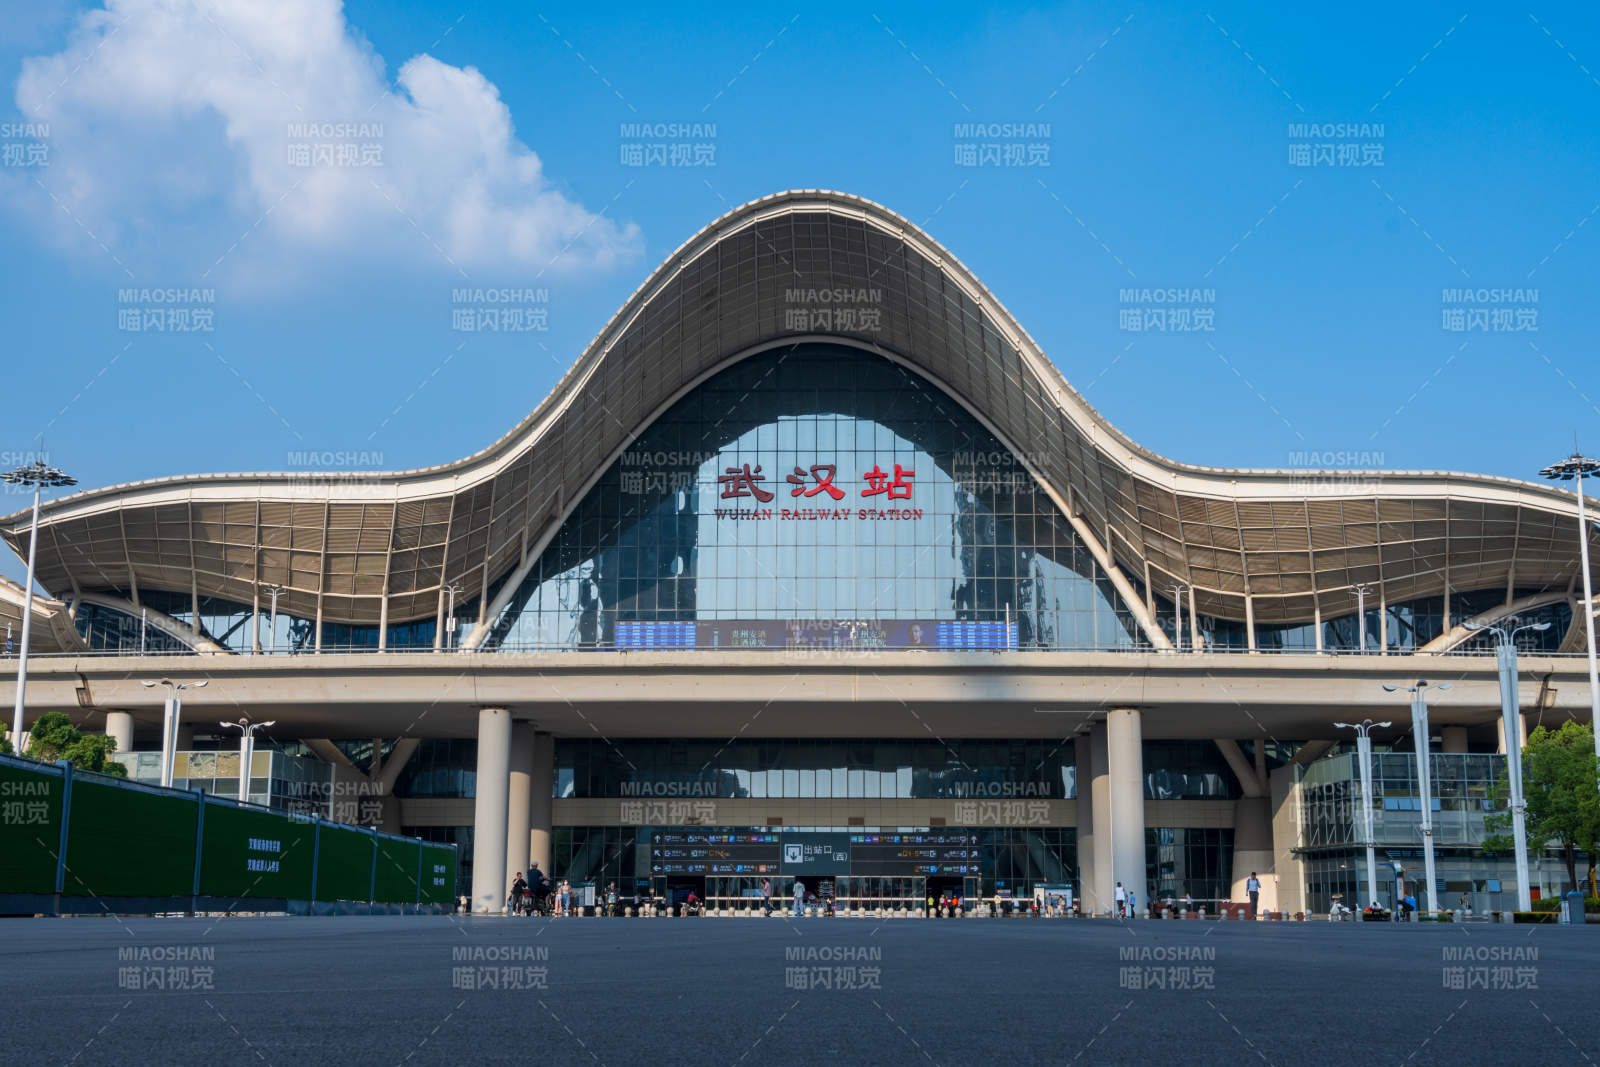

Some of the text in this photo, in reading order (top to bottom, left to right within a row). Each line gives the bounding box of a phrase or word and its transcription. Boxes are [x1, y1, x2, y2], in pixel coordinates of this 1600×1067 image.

[718, 463, 915, 503] 武汉站
[714, 509, 923, 520] WUHAN RAILWAY STATION
[804, 845, 832, 854] 出站口
